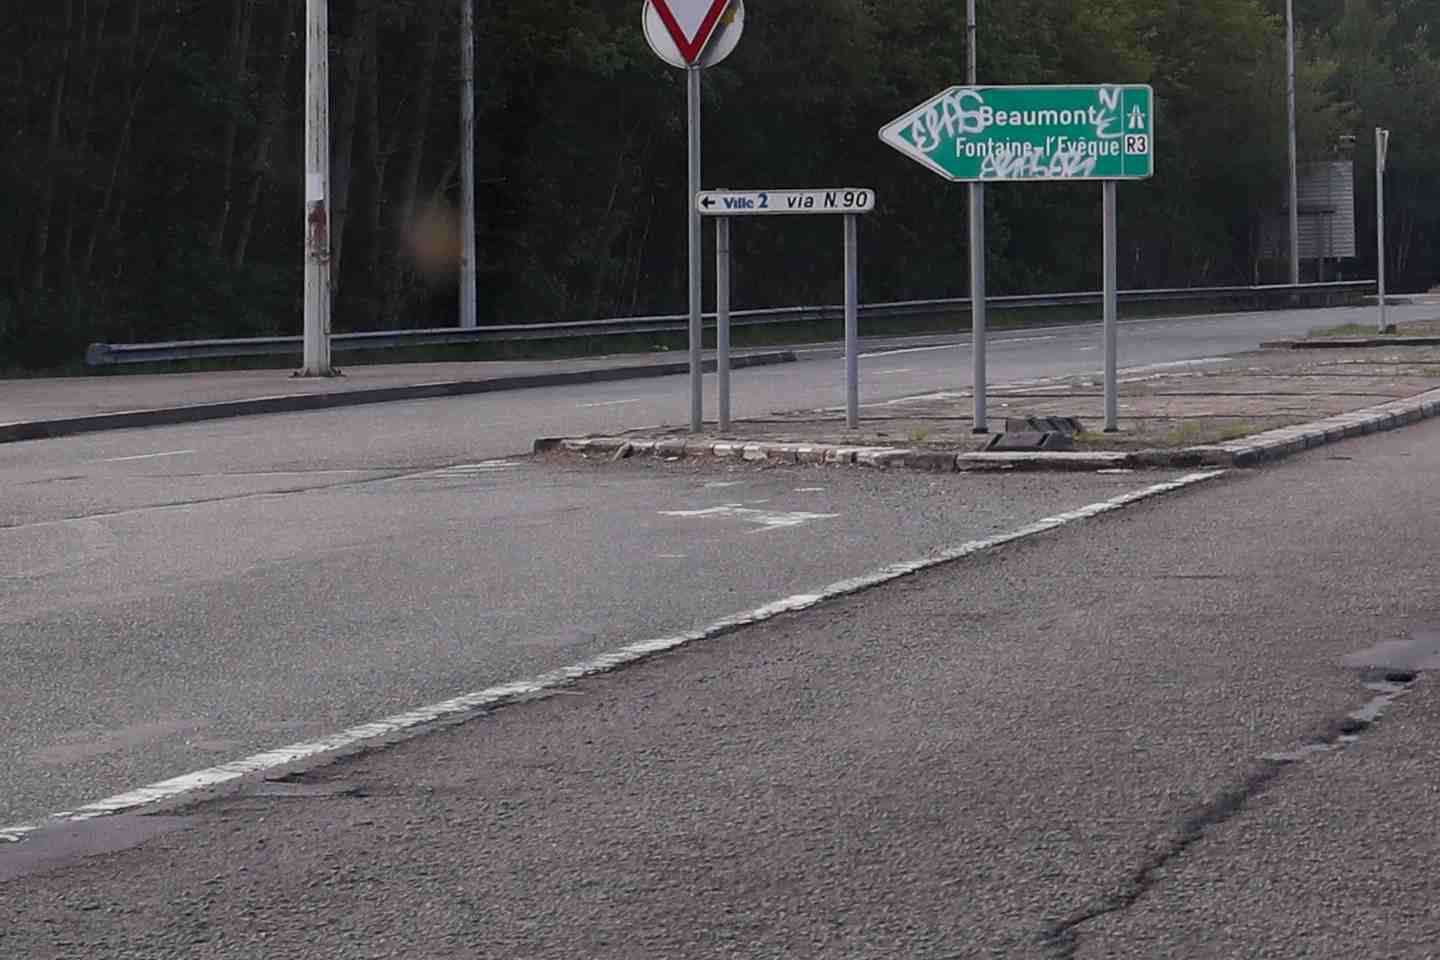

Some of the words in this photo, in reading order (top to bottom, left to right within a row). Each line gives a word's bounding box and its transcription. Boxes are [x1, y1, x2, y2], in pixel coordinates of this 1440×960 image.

[979, 105, 1096, 127] Beaumont
[1127, 137, 1146, 153] R3
[723, 197, 753, 209] Ville
[758, 192, 768, 208] 2
[787, 193, 815, 208] via
